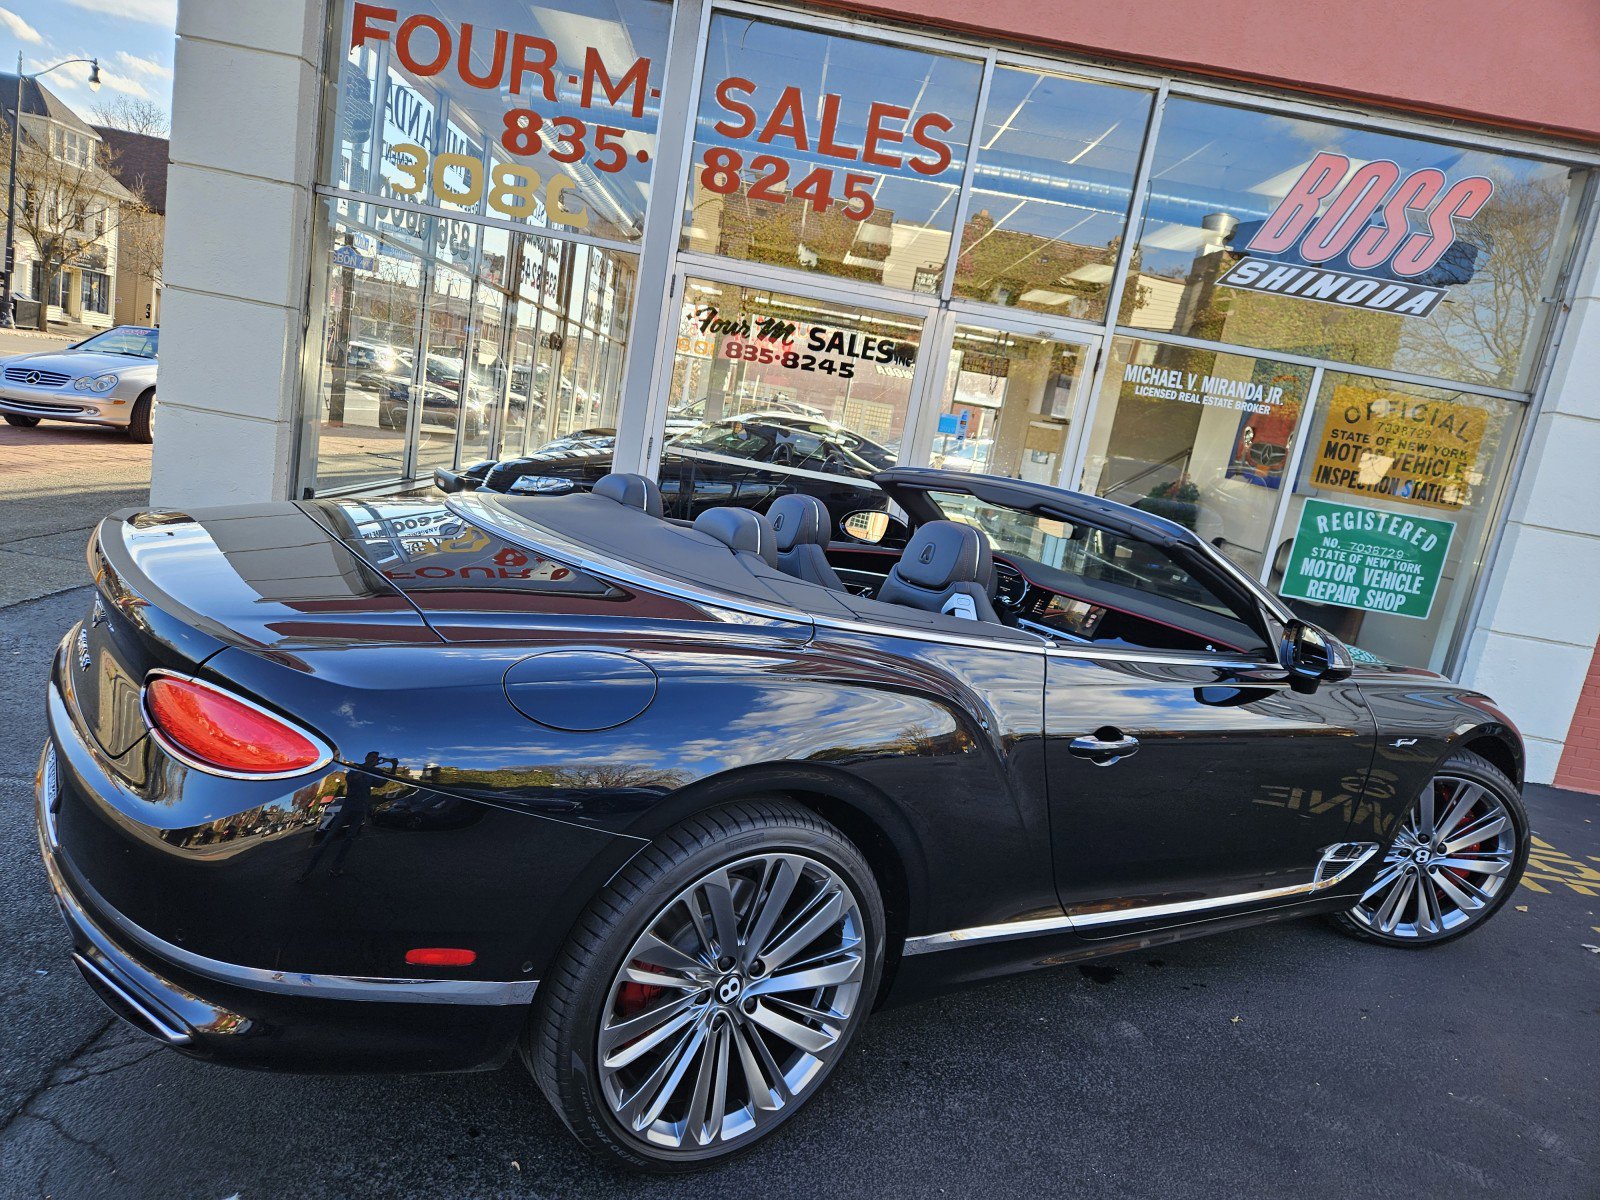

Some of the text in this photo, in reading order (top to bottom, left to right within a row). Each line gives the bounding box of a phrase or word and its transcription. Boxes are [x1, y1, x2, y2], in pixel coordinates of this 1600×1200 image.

[713, 76, 954, 176] SALES
[701, 147, 875, 221] 8245
[1245, 151, 1494, 277] BOSS
[1226, 261, 1438, 315] SHINODA
[808, 327, 895, 363] SALES
[1124, 364, 1284, 405] MICHAEL V. MIRANDA JR.
[1135, 385, 1271, 415] LICENSED REAL ESTATE BROKER
[1323, 440, 1468, 481] MOT VEHICLE
[1331, 428, 1468, 460] STATE OF NEW YORK
[1316, 511, 1438, 552] REGISTERED
[1322, 537, 1404, 559] NO. 7038729
[1300, 557, 1424, 595] MOTOR VEHICLE
[1311, 547, 1422, 575] STATE OF NEW YORK
[1306, 579, 1406, 612] REPAIR SHOP
